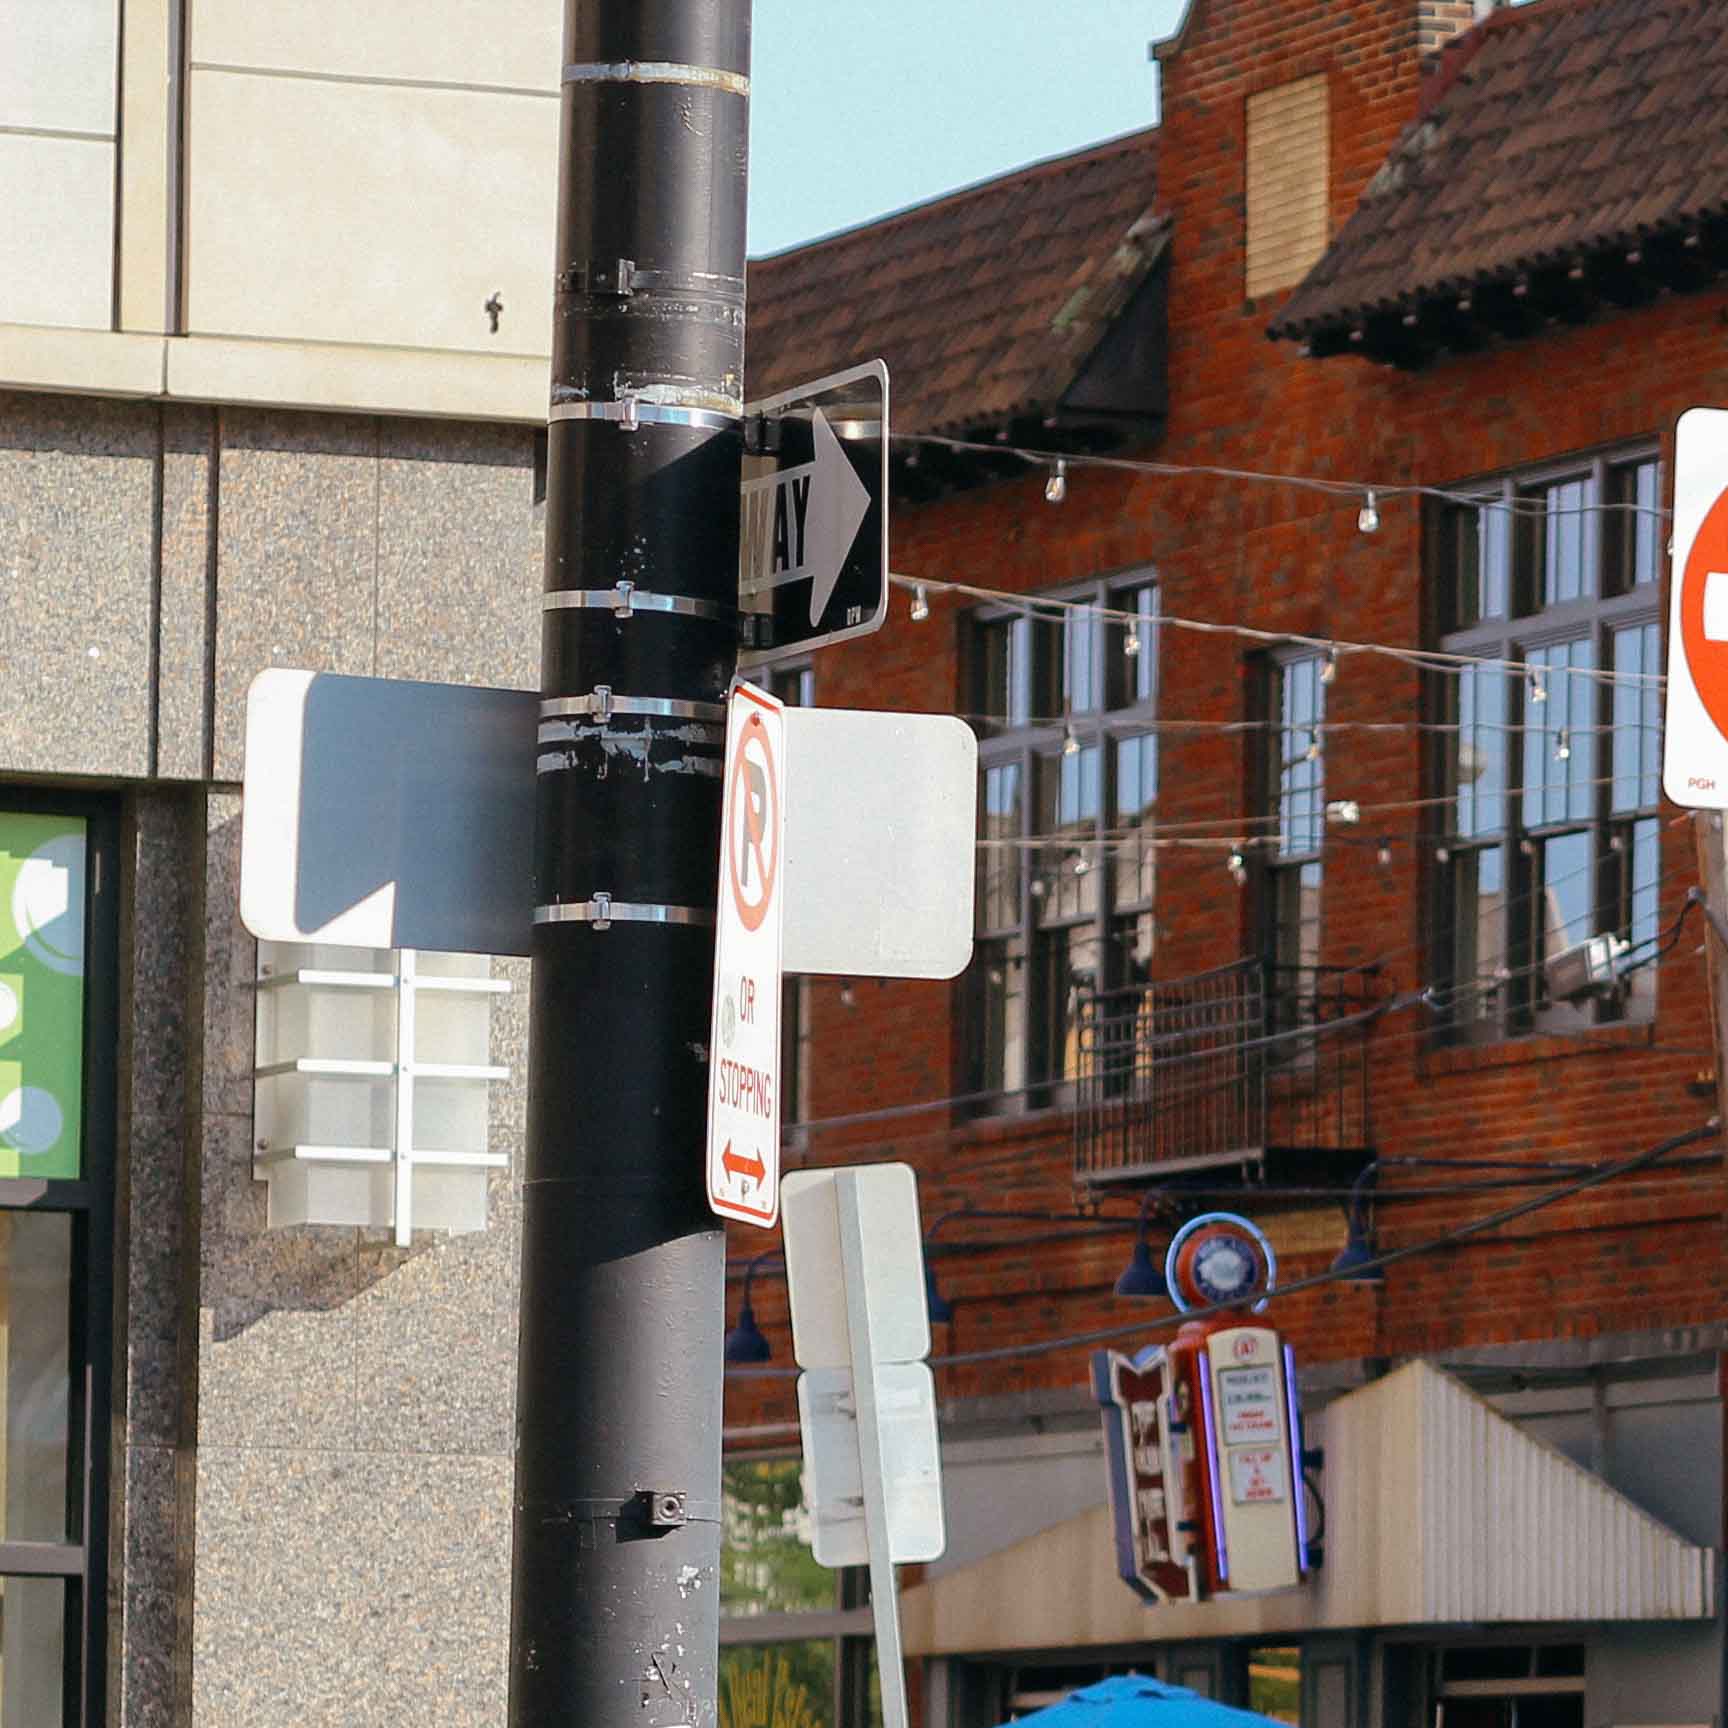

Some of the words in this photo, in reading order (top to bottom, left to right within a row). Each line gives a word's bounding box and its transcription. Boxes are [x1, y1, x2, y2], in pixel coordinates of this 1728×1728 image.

[1688, 776, 1715, 791] PGH
[740, 976, 754, 1025] OR
[719, 1057, 771, 1121] STOPPING
